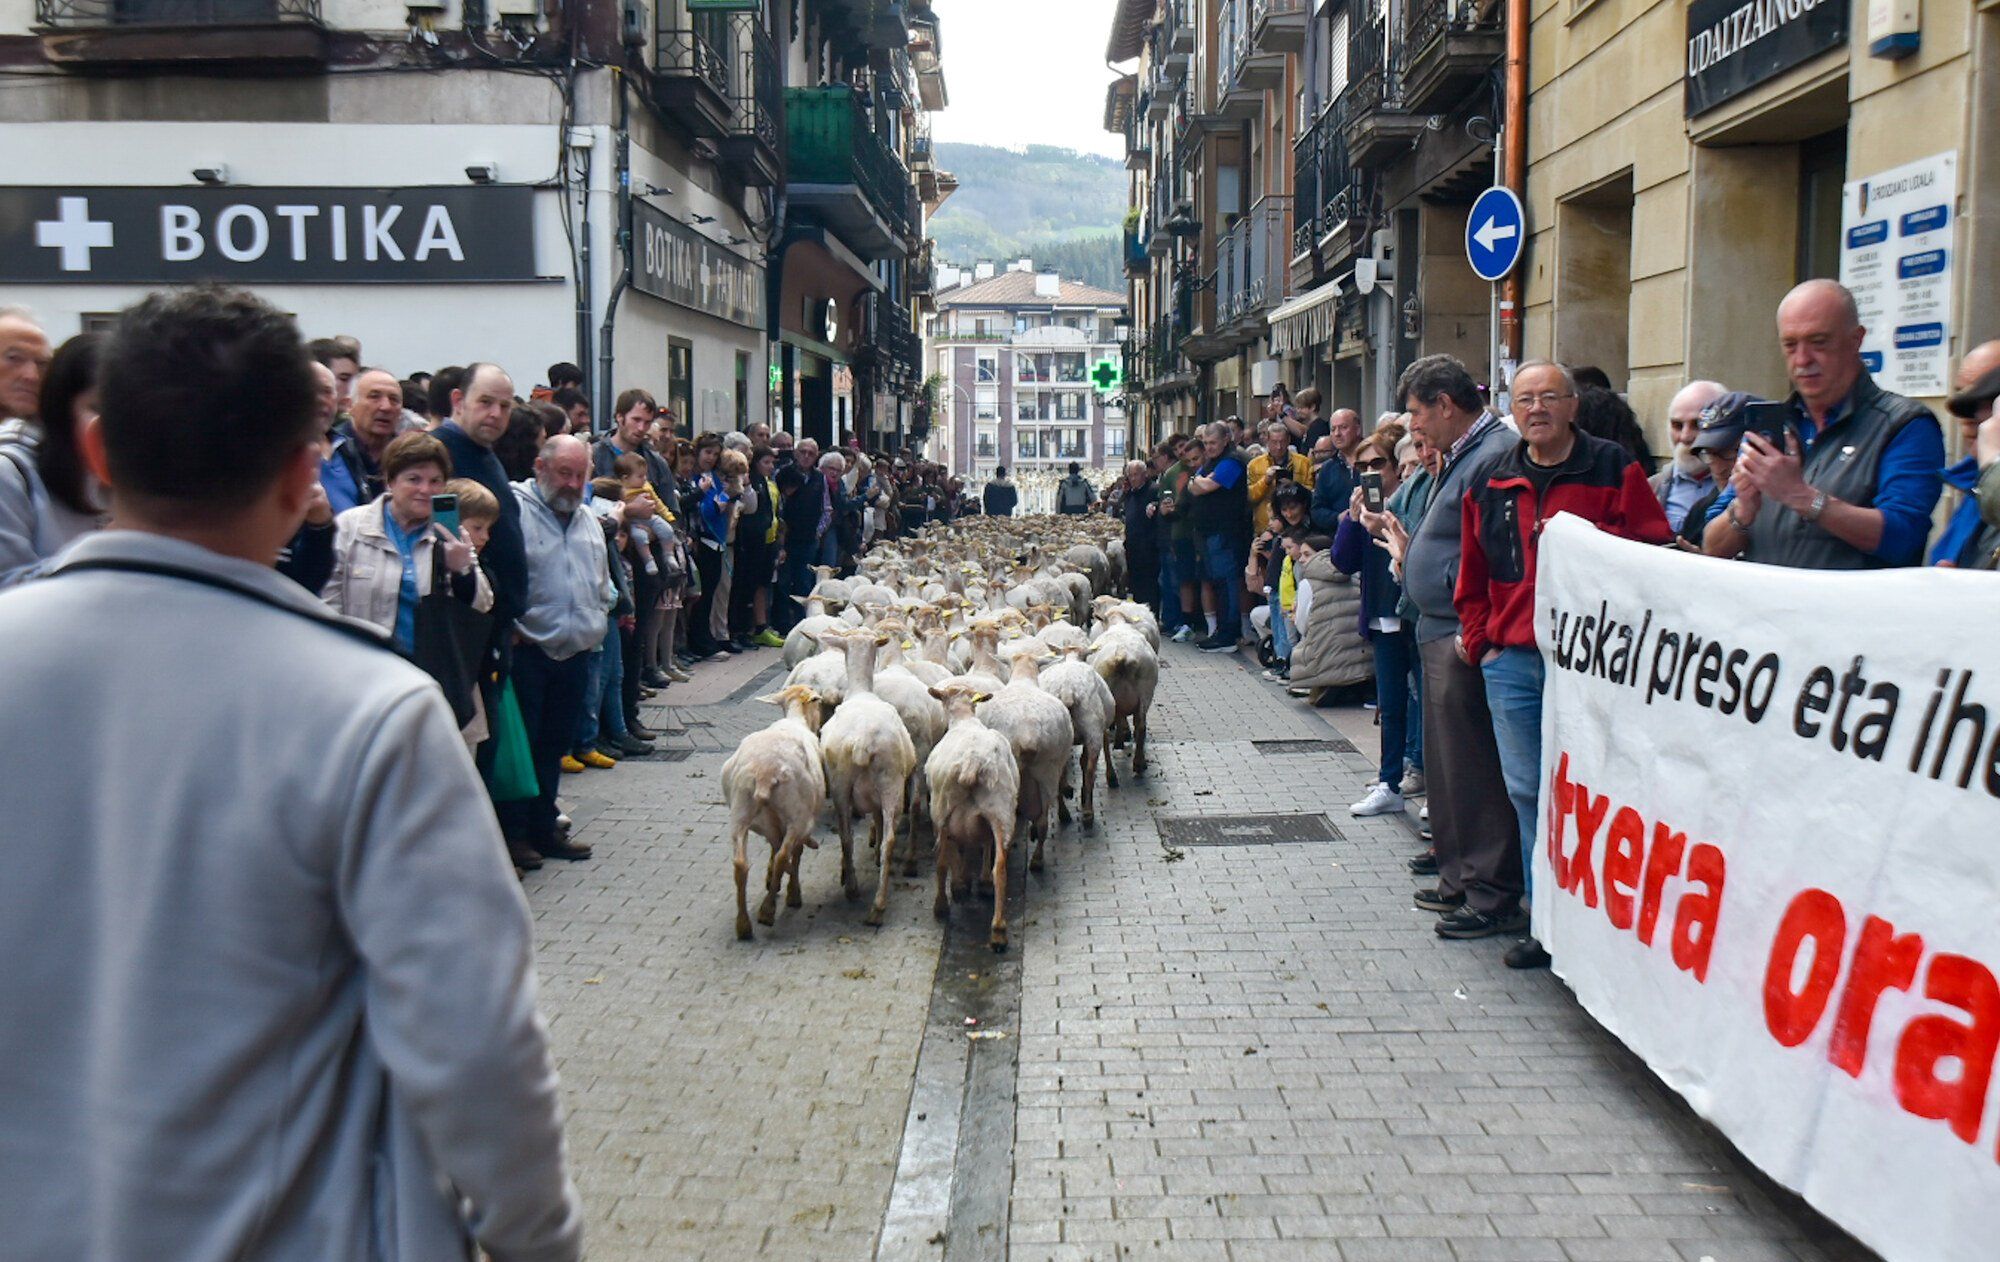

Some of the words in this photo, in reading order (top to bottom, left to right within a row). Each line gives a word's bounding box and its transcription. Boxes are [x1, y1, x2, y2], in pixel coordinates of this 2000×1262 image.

[1689, 0, 1825, 77] UDALTZAING
[160, 204, 465, 262] BOTIKA
[645, 221, 693, 291] BOTIKA
[1645, 627, 1779, 724] preso
[1793, 654, 1900, 762] eta
[1548, 750, 1726, 984] txera
[1763, 887, 2000, 1167] ora
